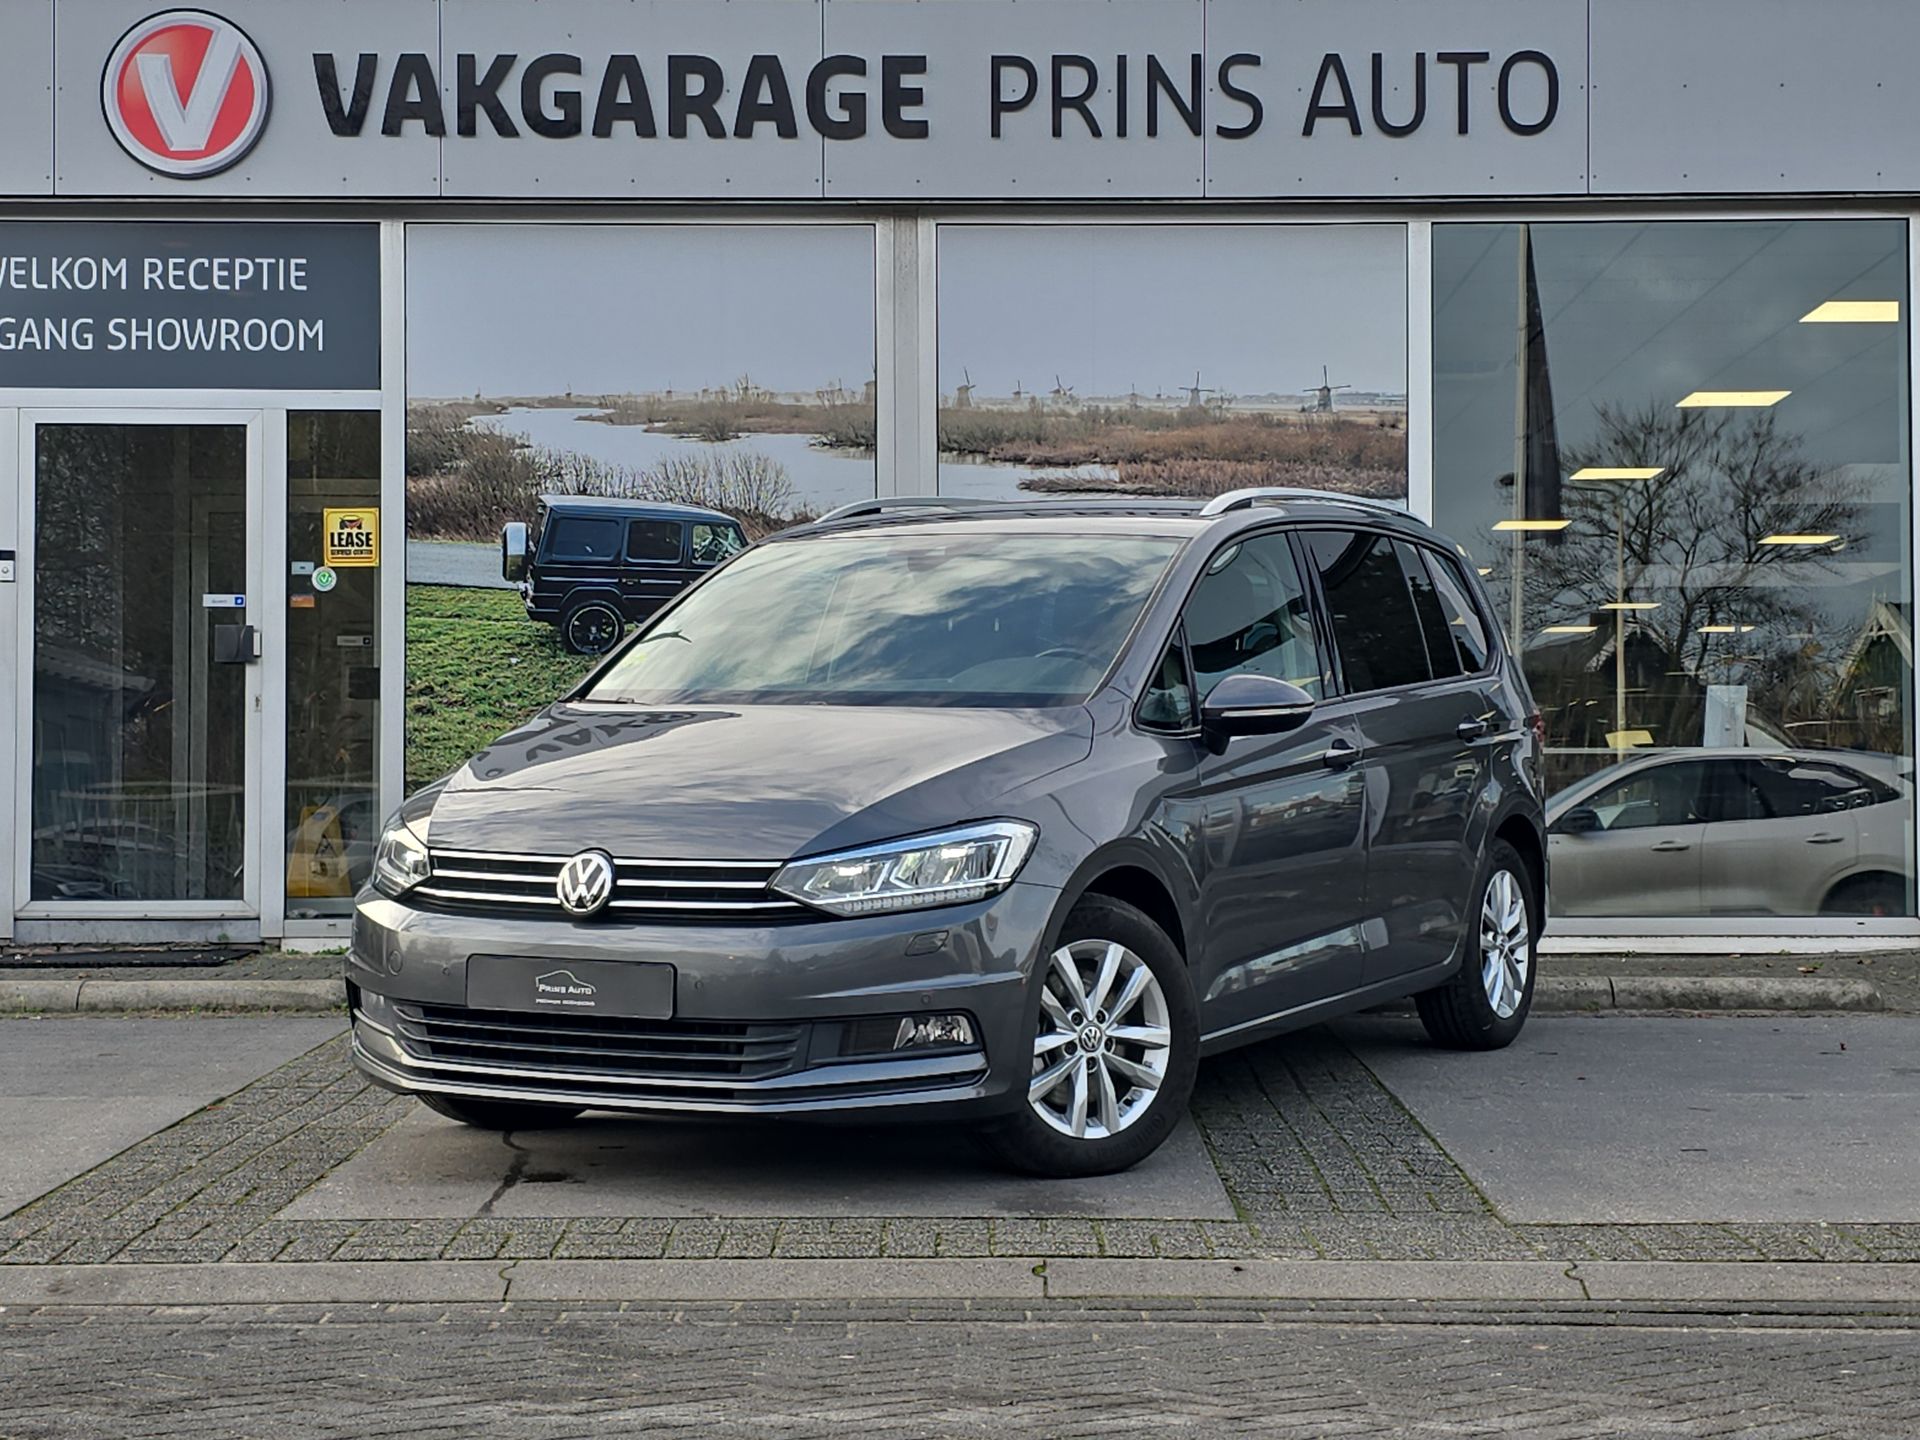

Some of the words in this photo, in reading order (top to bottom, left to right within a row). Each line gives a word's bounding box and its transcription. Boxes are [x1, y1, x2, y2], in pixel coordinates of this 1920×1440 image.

[313, 53, 930, 140] VAKGARAGE
[990, 53, 1264, 140] PRINS
[1301, 49, 1559, 139] AUTO
[0, 256, 127, 290] ELKOM
[143, 257, 308, 291] RECEPTIE
[0, 317, 94, 350] GANG
[107, 318, 324, 351] SHOWROOM
[330, 531, 373, 548] LEASE
